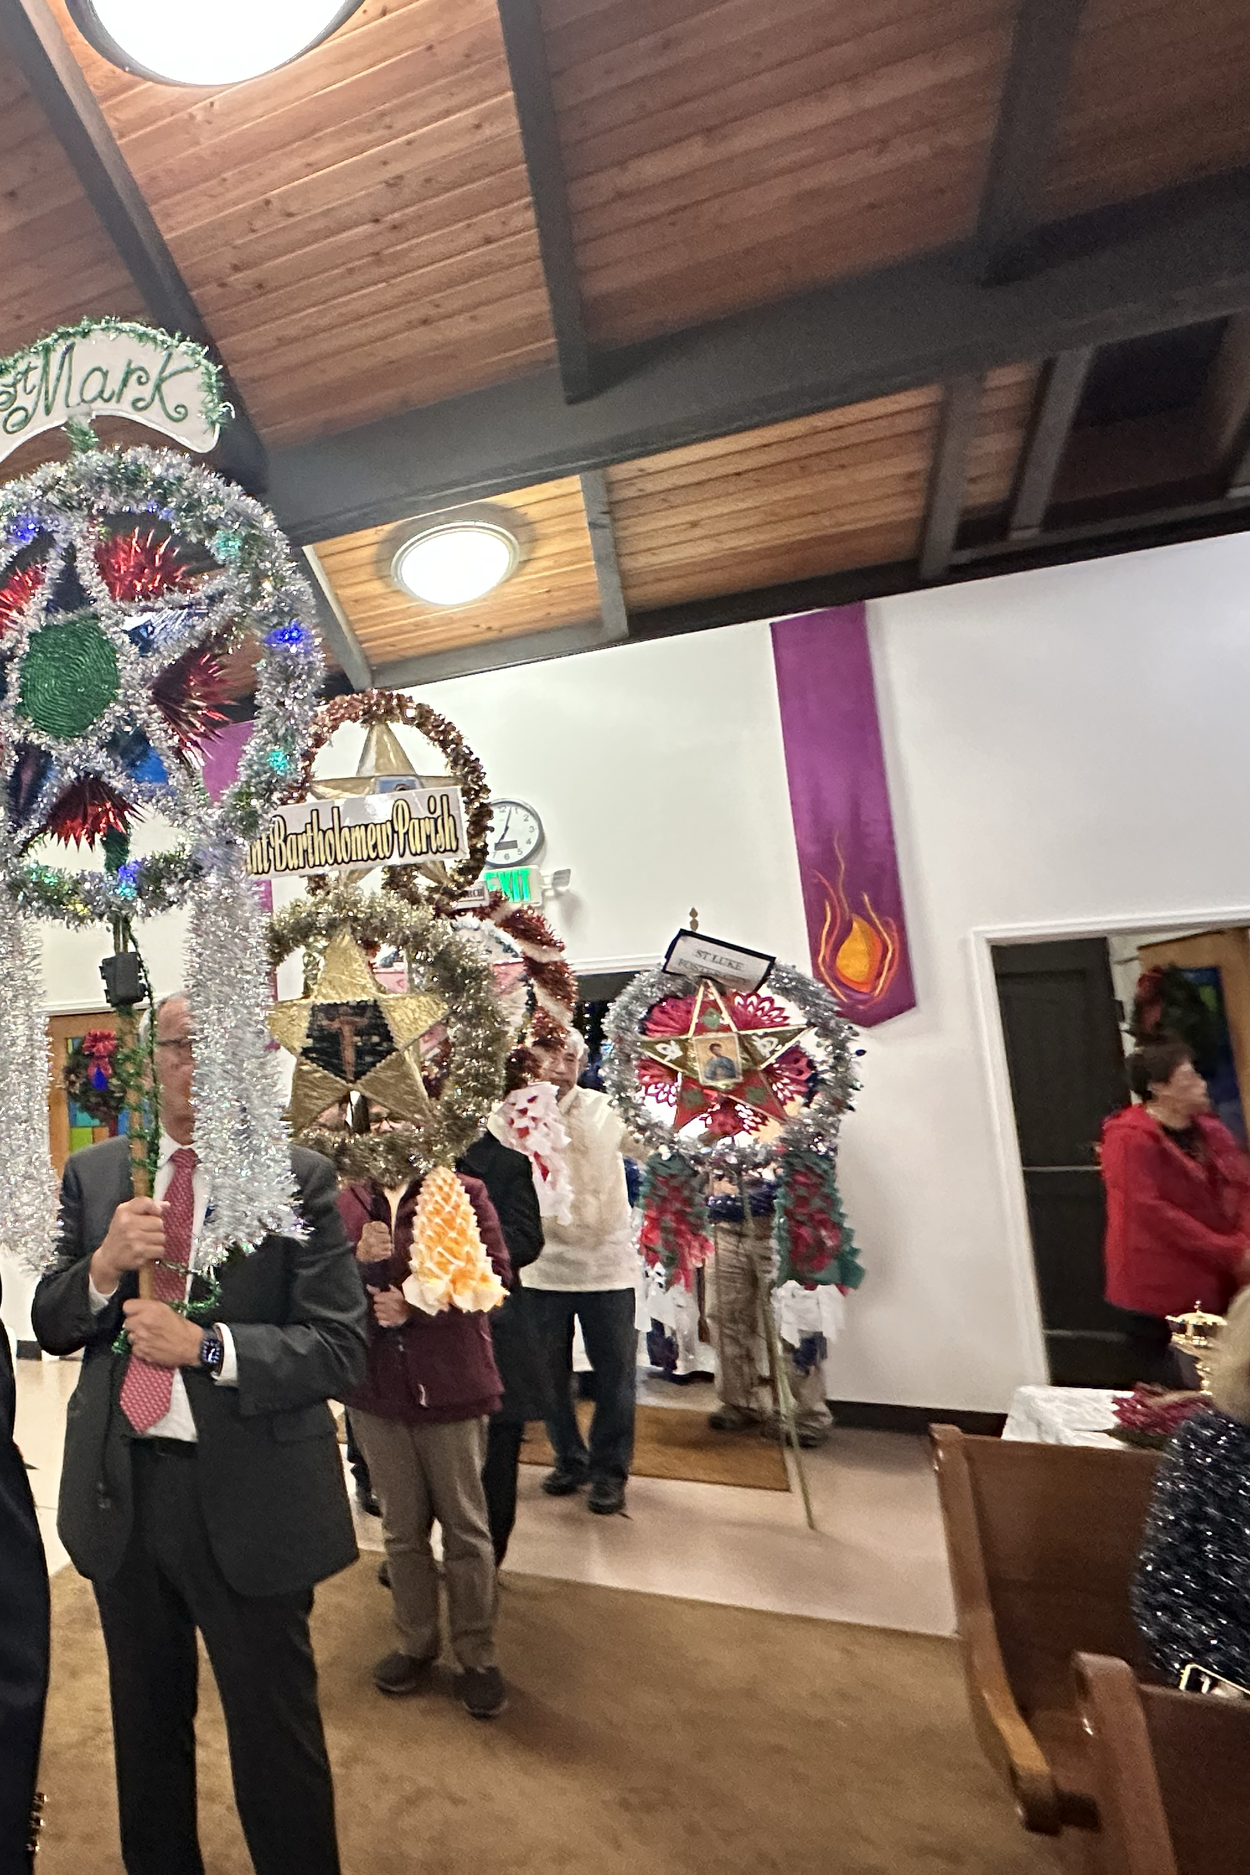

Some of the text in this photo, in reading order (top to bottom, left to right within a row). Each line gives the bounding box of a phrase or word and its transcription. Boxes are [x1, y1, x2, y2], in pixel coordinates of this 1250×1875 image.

[270, 805, 392, 873] Bartholomew
[391, 794, 460, 858] Parish
[484, 867, 531, 903] EXIT
